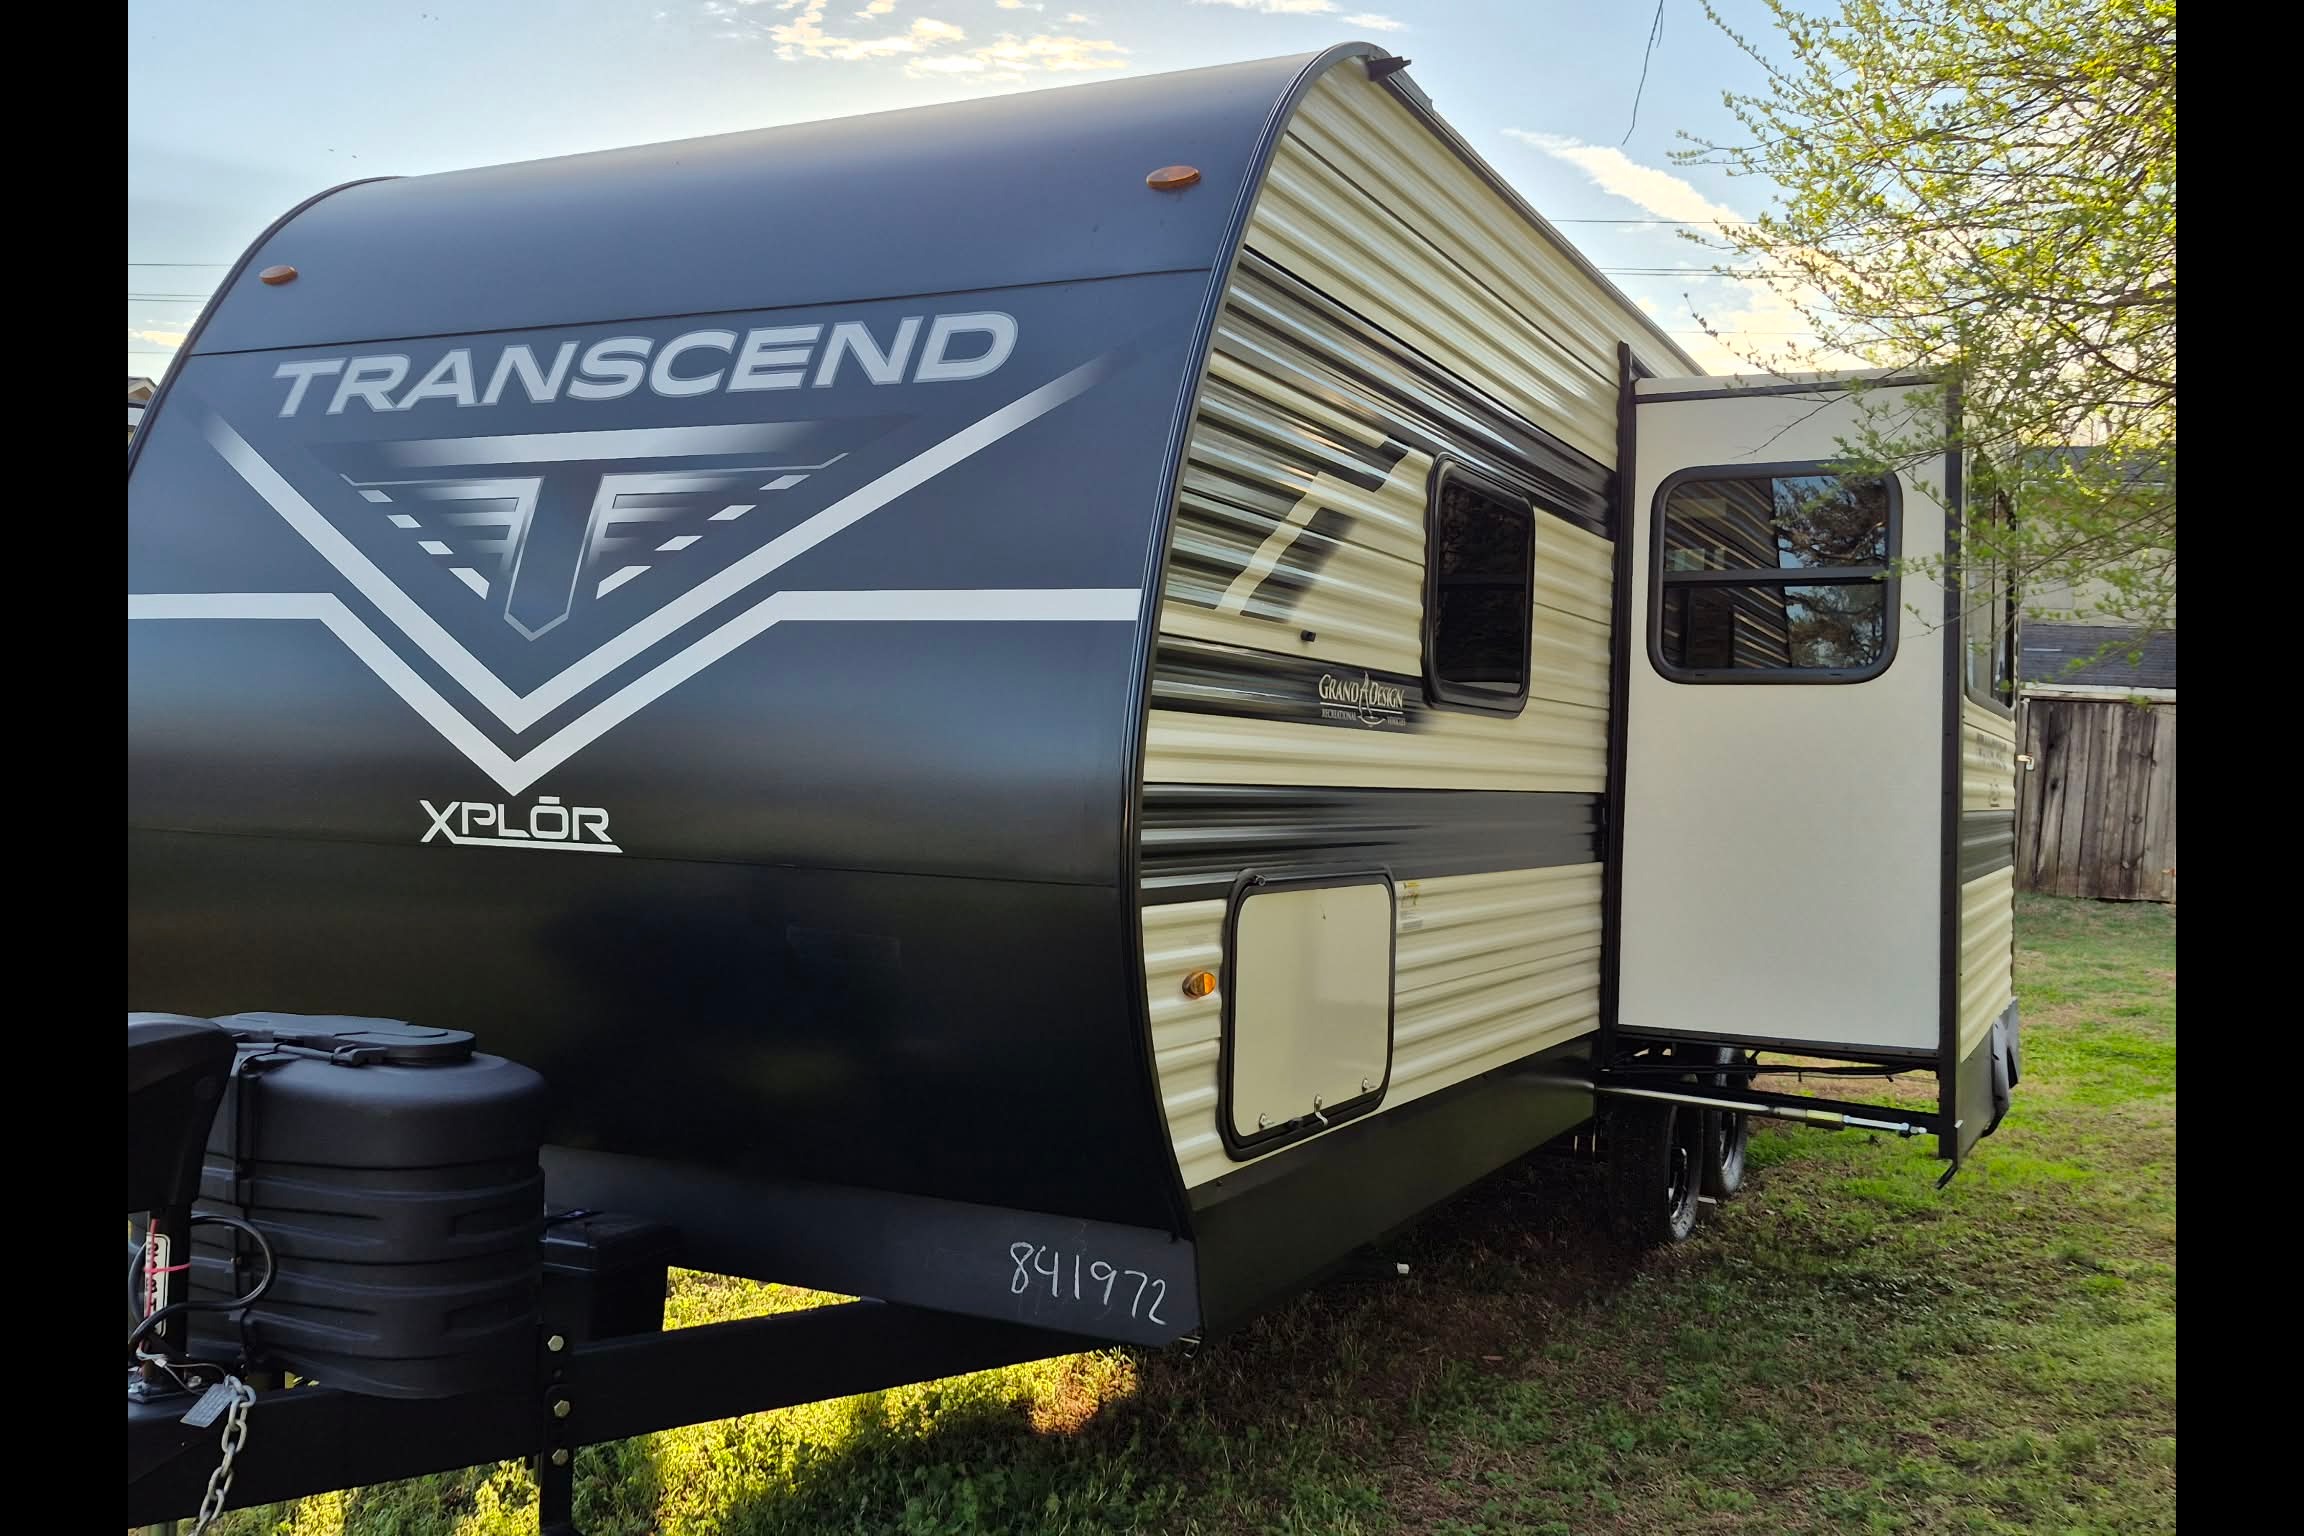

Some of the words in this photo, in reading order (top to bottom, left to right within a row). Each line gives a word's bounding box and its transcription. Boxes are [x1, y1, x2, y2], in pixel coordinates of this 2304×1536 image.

[273, 311, 1018, 417] TRANSCEND
[1319, 674, 1359, 702] GRAND
[1369, 682, 1404, 708] DESIGN
[1010, 1241, 1167, 1325] 841972
